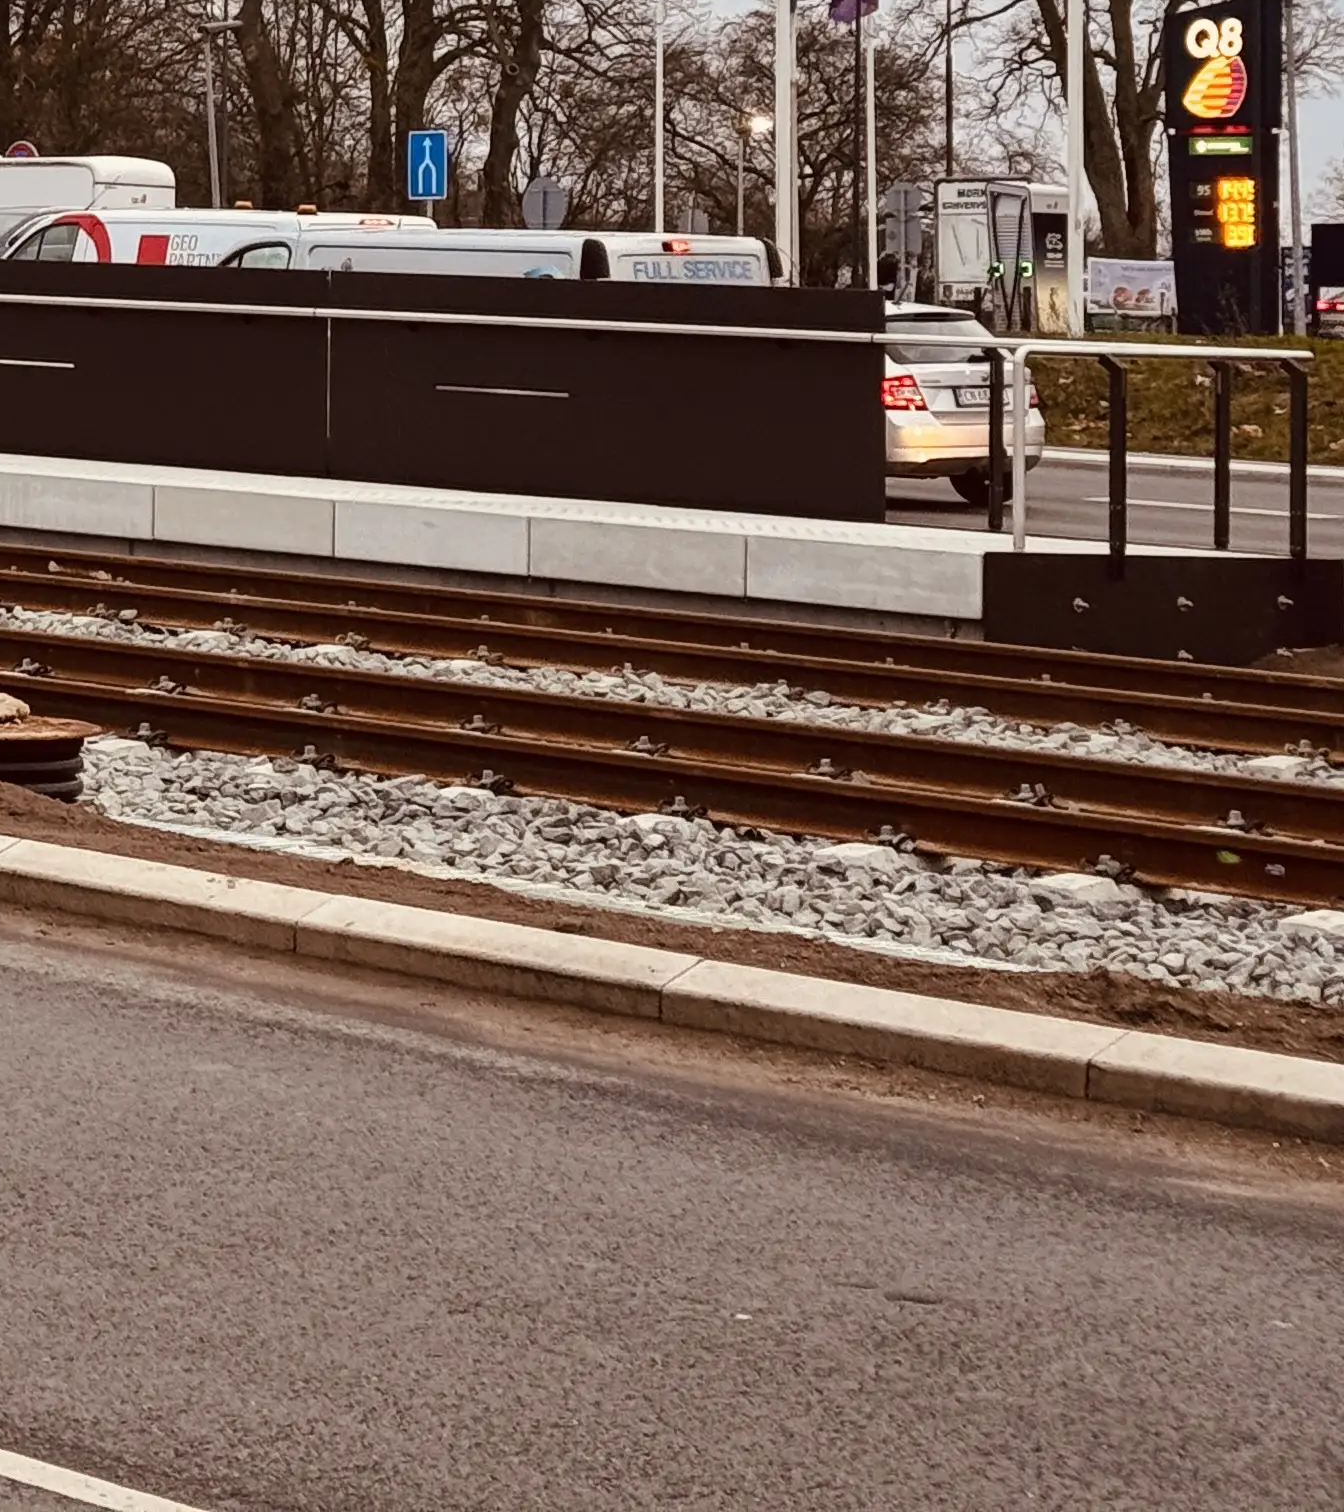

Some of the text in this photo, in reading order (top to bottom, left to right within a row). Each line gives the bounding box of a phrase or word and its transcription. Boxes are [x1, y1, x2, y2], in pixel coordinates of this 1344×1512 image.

[1186, 17, 1243, 58] Q8
[171, 234, 199, 252] GEO
[169, 252, 222, 267] PARTN
[633, 260, 753, 280] FULL SERVICE
